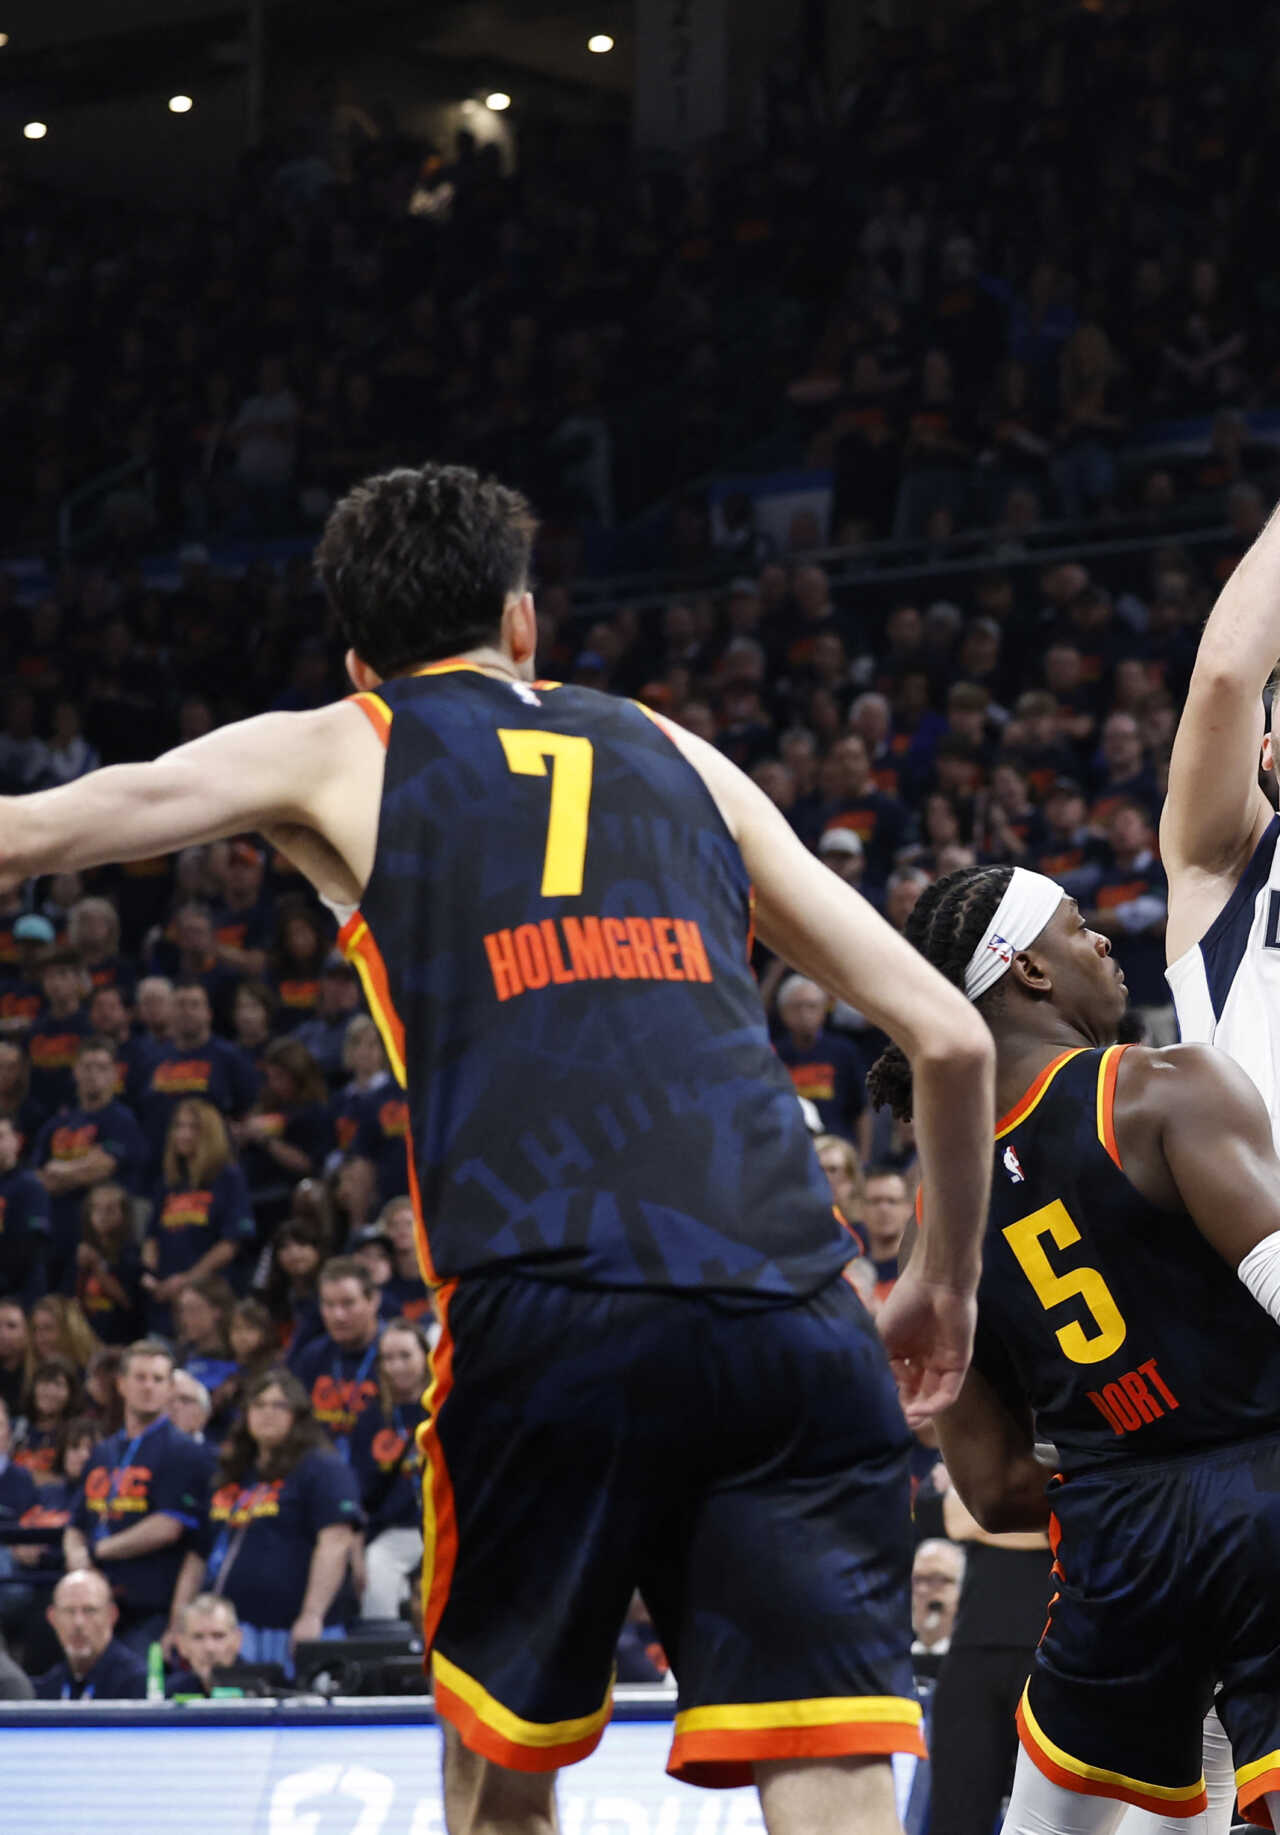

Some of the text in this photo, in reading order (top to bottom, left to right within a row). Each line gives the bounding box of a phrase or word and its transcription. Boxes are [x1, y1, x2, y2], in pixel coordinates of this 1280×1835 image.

[497, 728, 593, 897] 7
[483, 915, 714, 1002] HOLMGREN
[1001, 1197, 1127, 1365] 5
